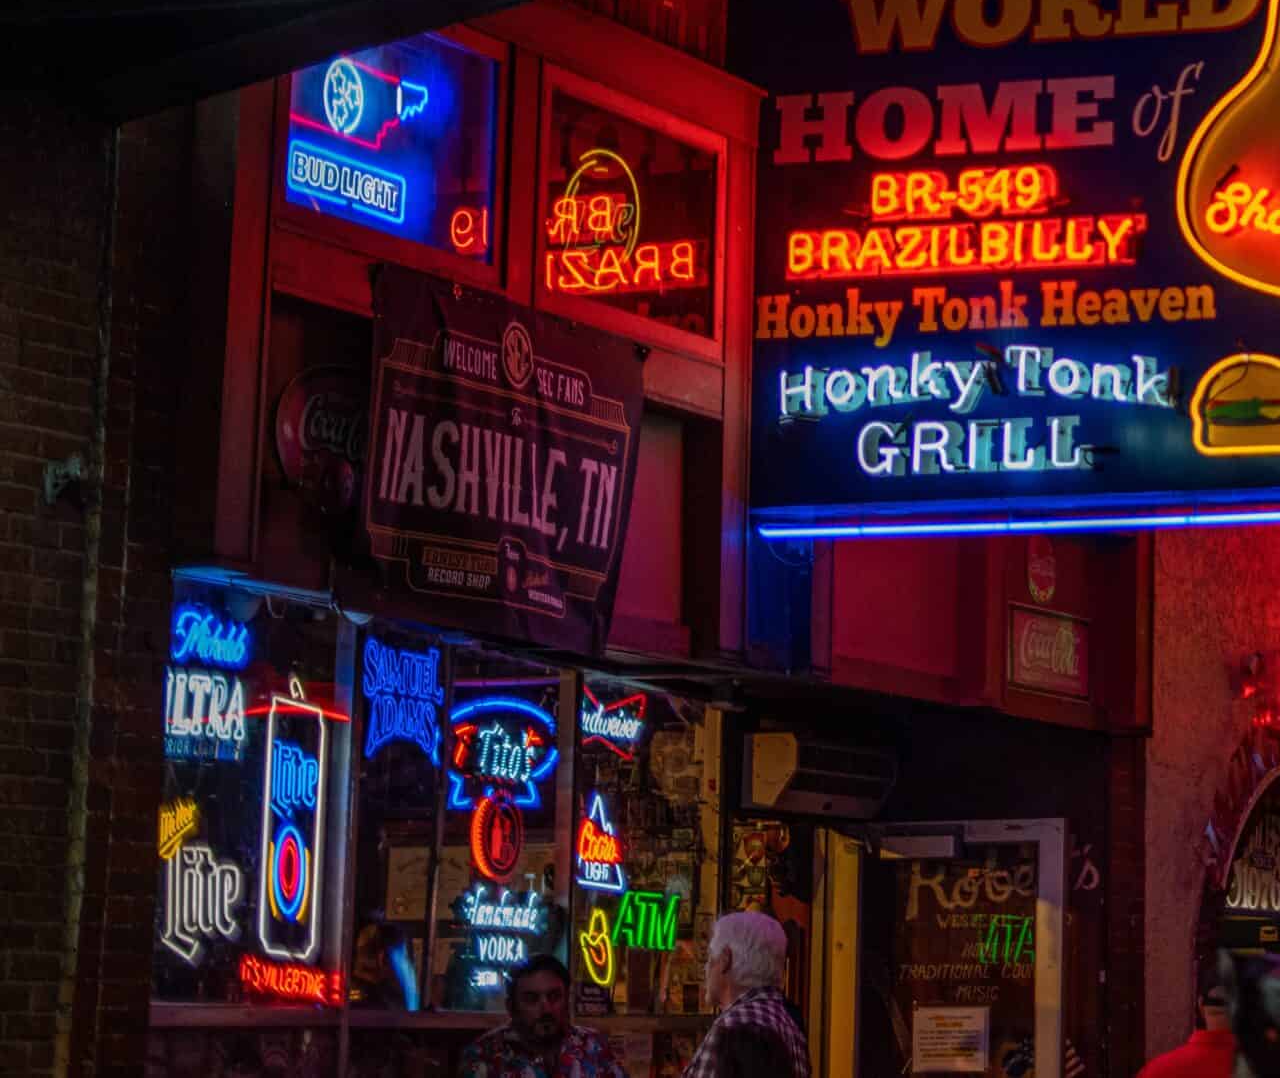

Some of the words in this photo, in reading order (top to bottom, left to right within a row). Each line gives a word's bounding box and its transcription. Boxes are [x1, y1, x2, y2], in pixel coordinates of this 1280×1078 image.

[772, 74, 1117, 165] HOME
[1131, 60, 1204, 163] of
[290, 150, 338, 190] BUD
[340, 169, 399, 213] LIGHT
[869, 165, 1056, 220] BR-549
[785, 214, 1146, 280] BRAZILBILLY
[756, 289, 903, 349] Honky
[911, 283, 1029, 333] Tonk
[1040, 279, 1216, 328] Heaven
[442, 337, 498, 381] WELCOME
[536, 367, 555, 399] SEC
[556, 374, 585, 407] FANS
[778, 346, 995, 422] Honky
[1004, 343, 1178, 410] Tonk
[377, 405, 569, 553] NASHVILLE,
[576, 458, 618, 550] TN
[857, 414, 1096, 476] GRILL
[362, 636, 445, 706] SAMUEL
[363, 693, 442, 764] ADAMS
[582, 702, 642, 740] udweiser
[271, 740, 320, 818] Lite
[161, 845, 243, 962] Lite
[612, 889, 681, 952] ATM
[478, 936, 524, 962] VODKA
